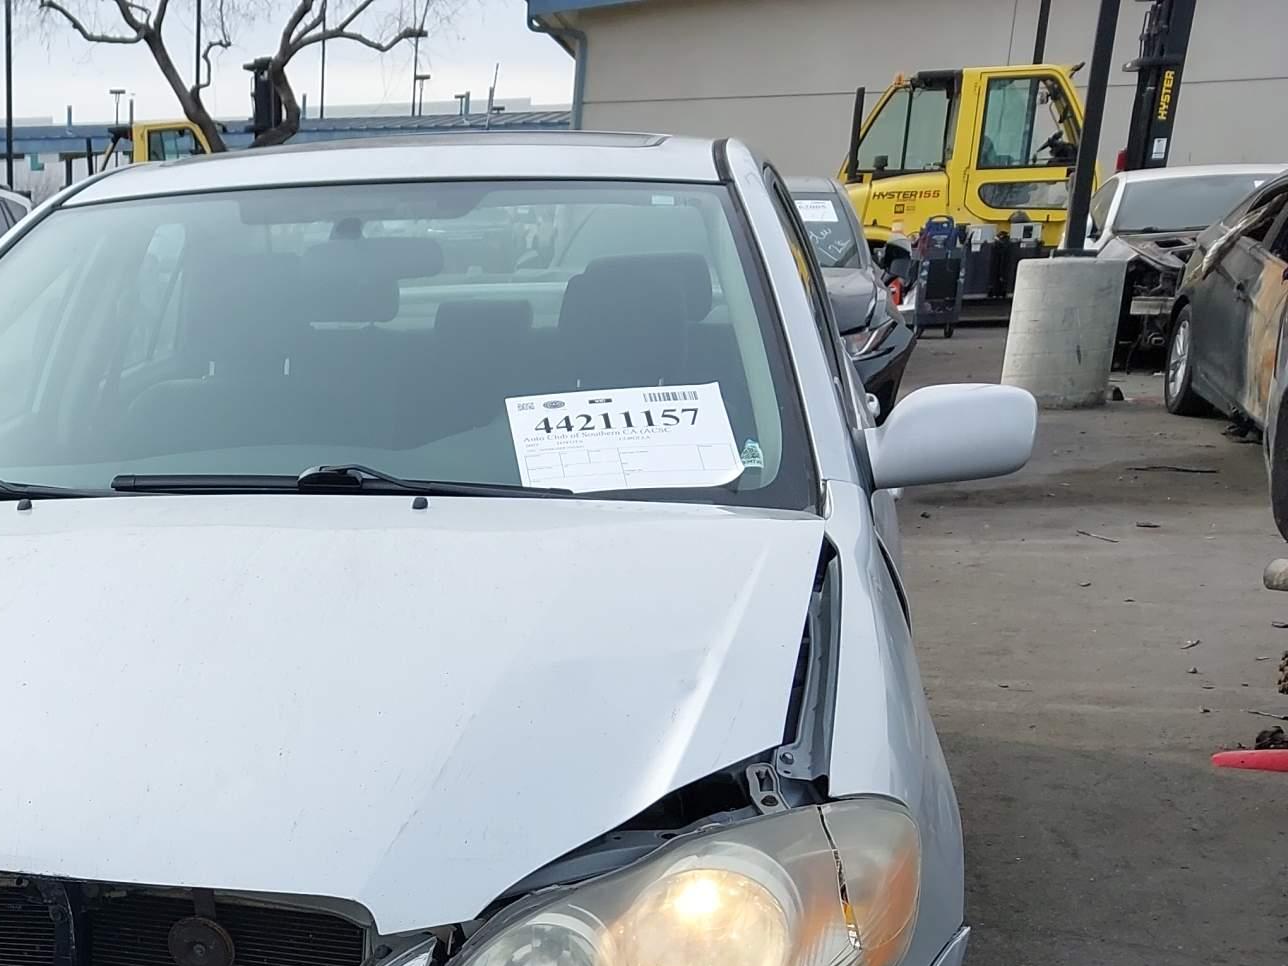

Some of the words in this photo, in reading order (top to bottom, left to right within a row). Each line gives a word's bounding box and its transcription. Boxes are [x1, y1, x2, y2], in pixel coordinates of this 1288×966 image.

[1158, 70, 1175, 120] HYSTER
[872, 190, 918, 200] HYSTER
[919, 190, 941, 199] 155
[534, 408, 699, 433] 44211157
